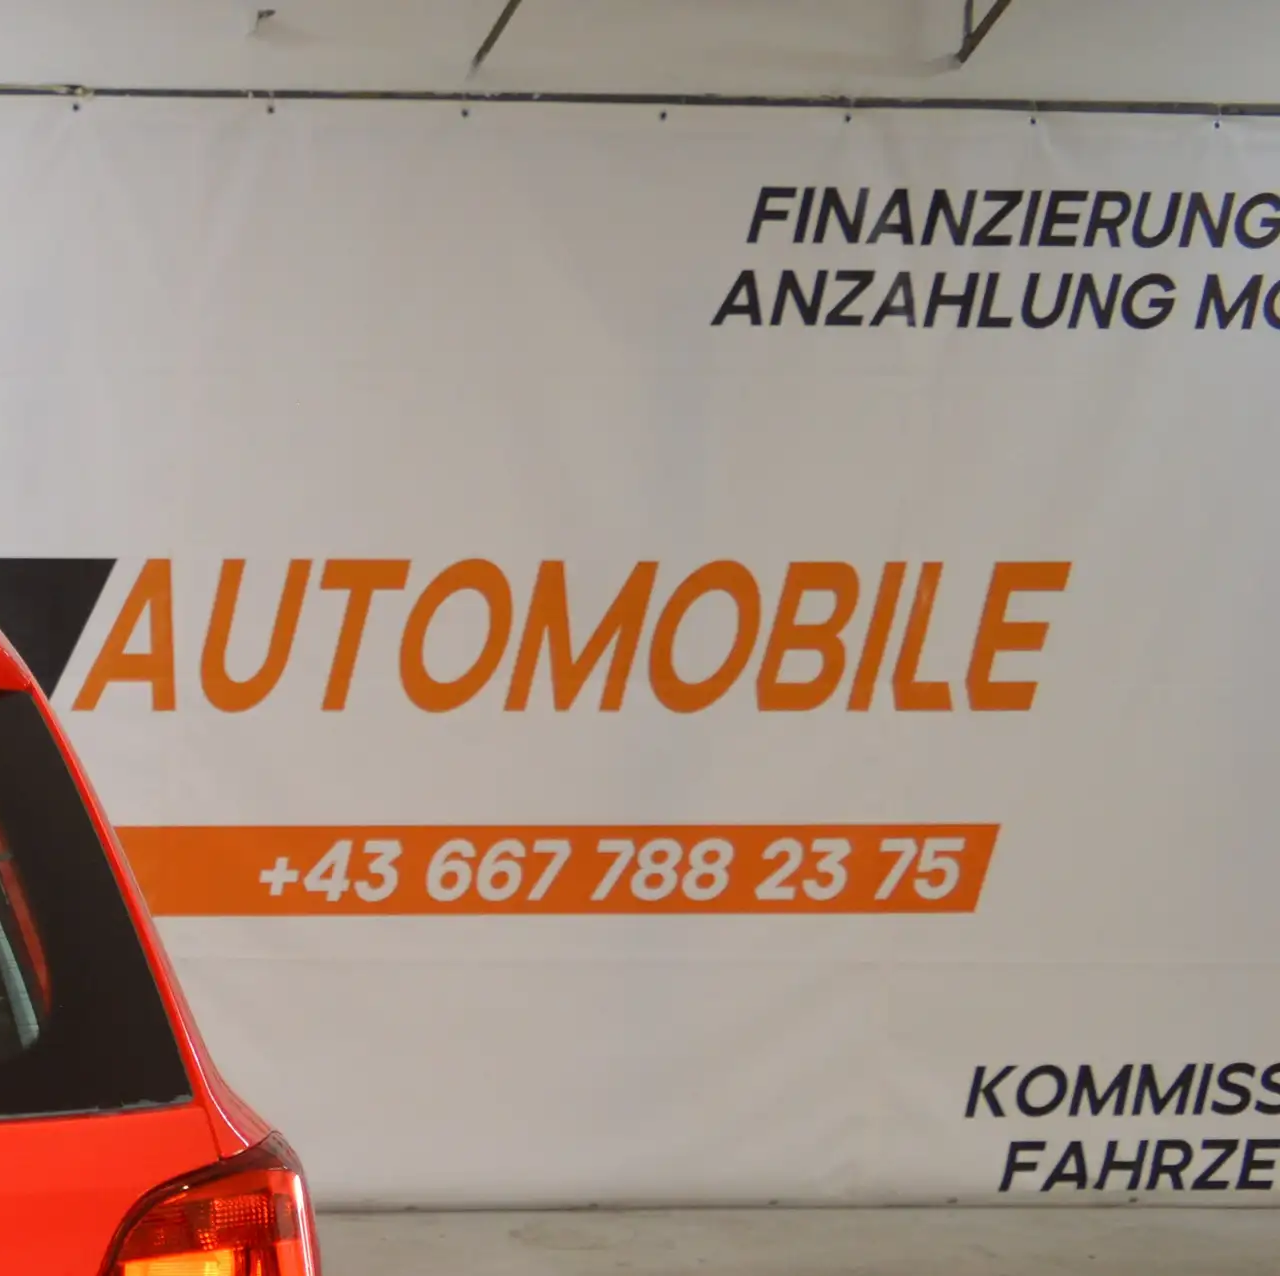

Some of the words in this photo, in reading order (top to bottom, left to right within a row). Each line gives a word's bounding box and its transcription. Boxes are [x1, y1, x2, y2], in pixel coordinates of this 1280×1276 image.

[746, 186, 1280, 249] FINANZIERUNG
[710, 269, 1176, 330] ANZAHLUNG
[72, 557, 1072, 714] AUTOMOBILE
[258, 839, 401, 904] +43
[423, 838, 571, 903] 667
[589, 838, 732, 902] 788
[753, 838, 849, 902] 23
[873, 837, 967, 900] 75
[964, 1062, 1280, 1118] KOMMISS
[997, 1139, 1280, 1192] FAHRZE
